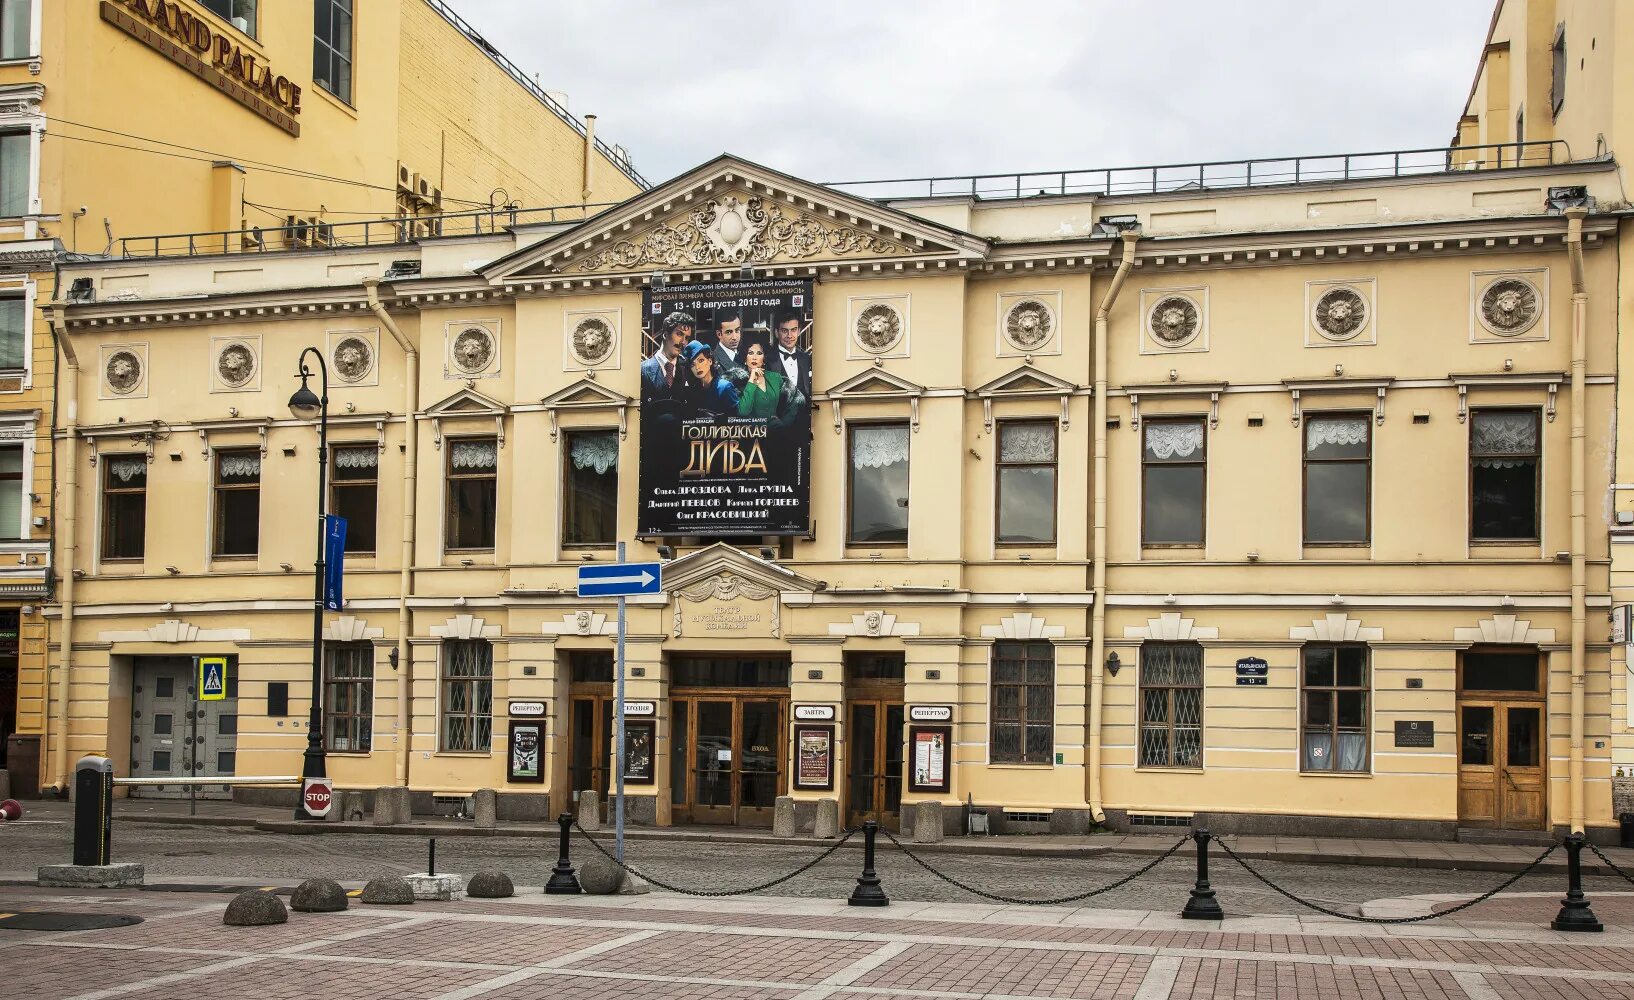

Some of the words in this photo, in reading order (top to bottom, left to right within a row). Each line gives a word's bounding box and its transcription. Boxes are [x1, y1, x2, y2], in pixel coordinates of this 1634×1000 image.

[115, 11, 204, 75] ГАЛЕРЕЯ
[218, 76, 296, 131] БУТИКОВ
[212, 33, 302, 115] PALACE
[651, 284, 714, 293] САНКТ-ПЕТЕРБУРГСКИЙ
[730, 281, 774, 289] МУЗЫКАЛЬНОЙ
[679, 292, 704, 300] ПРЕМЬЕРА
[674, 302, 684, 310] 13
[691, 301, 701, 309] 18
[703, 300, 737, 310] августа
[738, 298, 759, 307] 2015
[760, 298, 781, 307] года
[682, 425, 767, 440] ГОЛЛИВУДСКАЯ
[680, 440, 768, 479] ДИВА
[677, 486, 732, 495] ДРОЗДОВА
[759, 485, 794, 493] РУЛЛА
[681, 498, 721, 508] ПЕВЦОВ
[755, 498, 800, 507] ГОРДЕЕВ
[696, 508, 769, 520] КРАСОВИЦКИЙ
[692, 614, 760, 622] МУЗЫКАЛЬНОЙ
[306, 793, 330, 802] STOP
